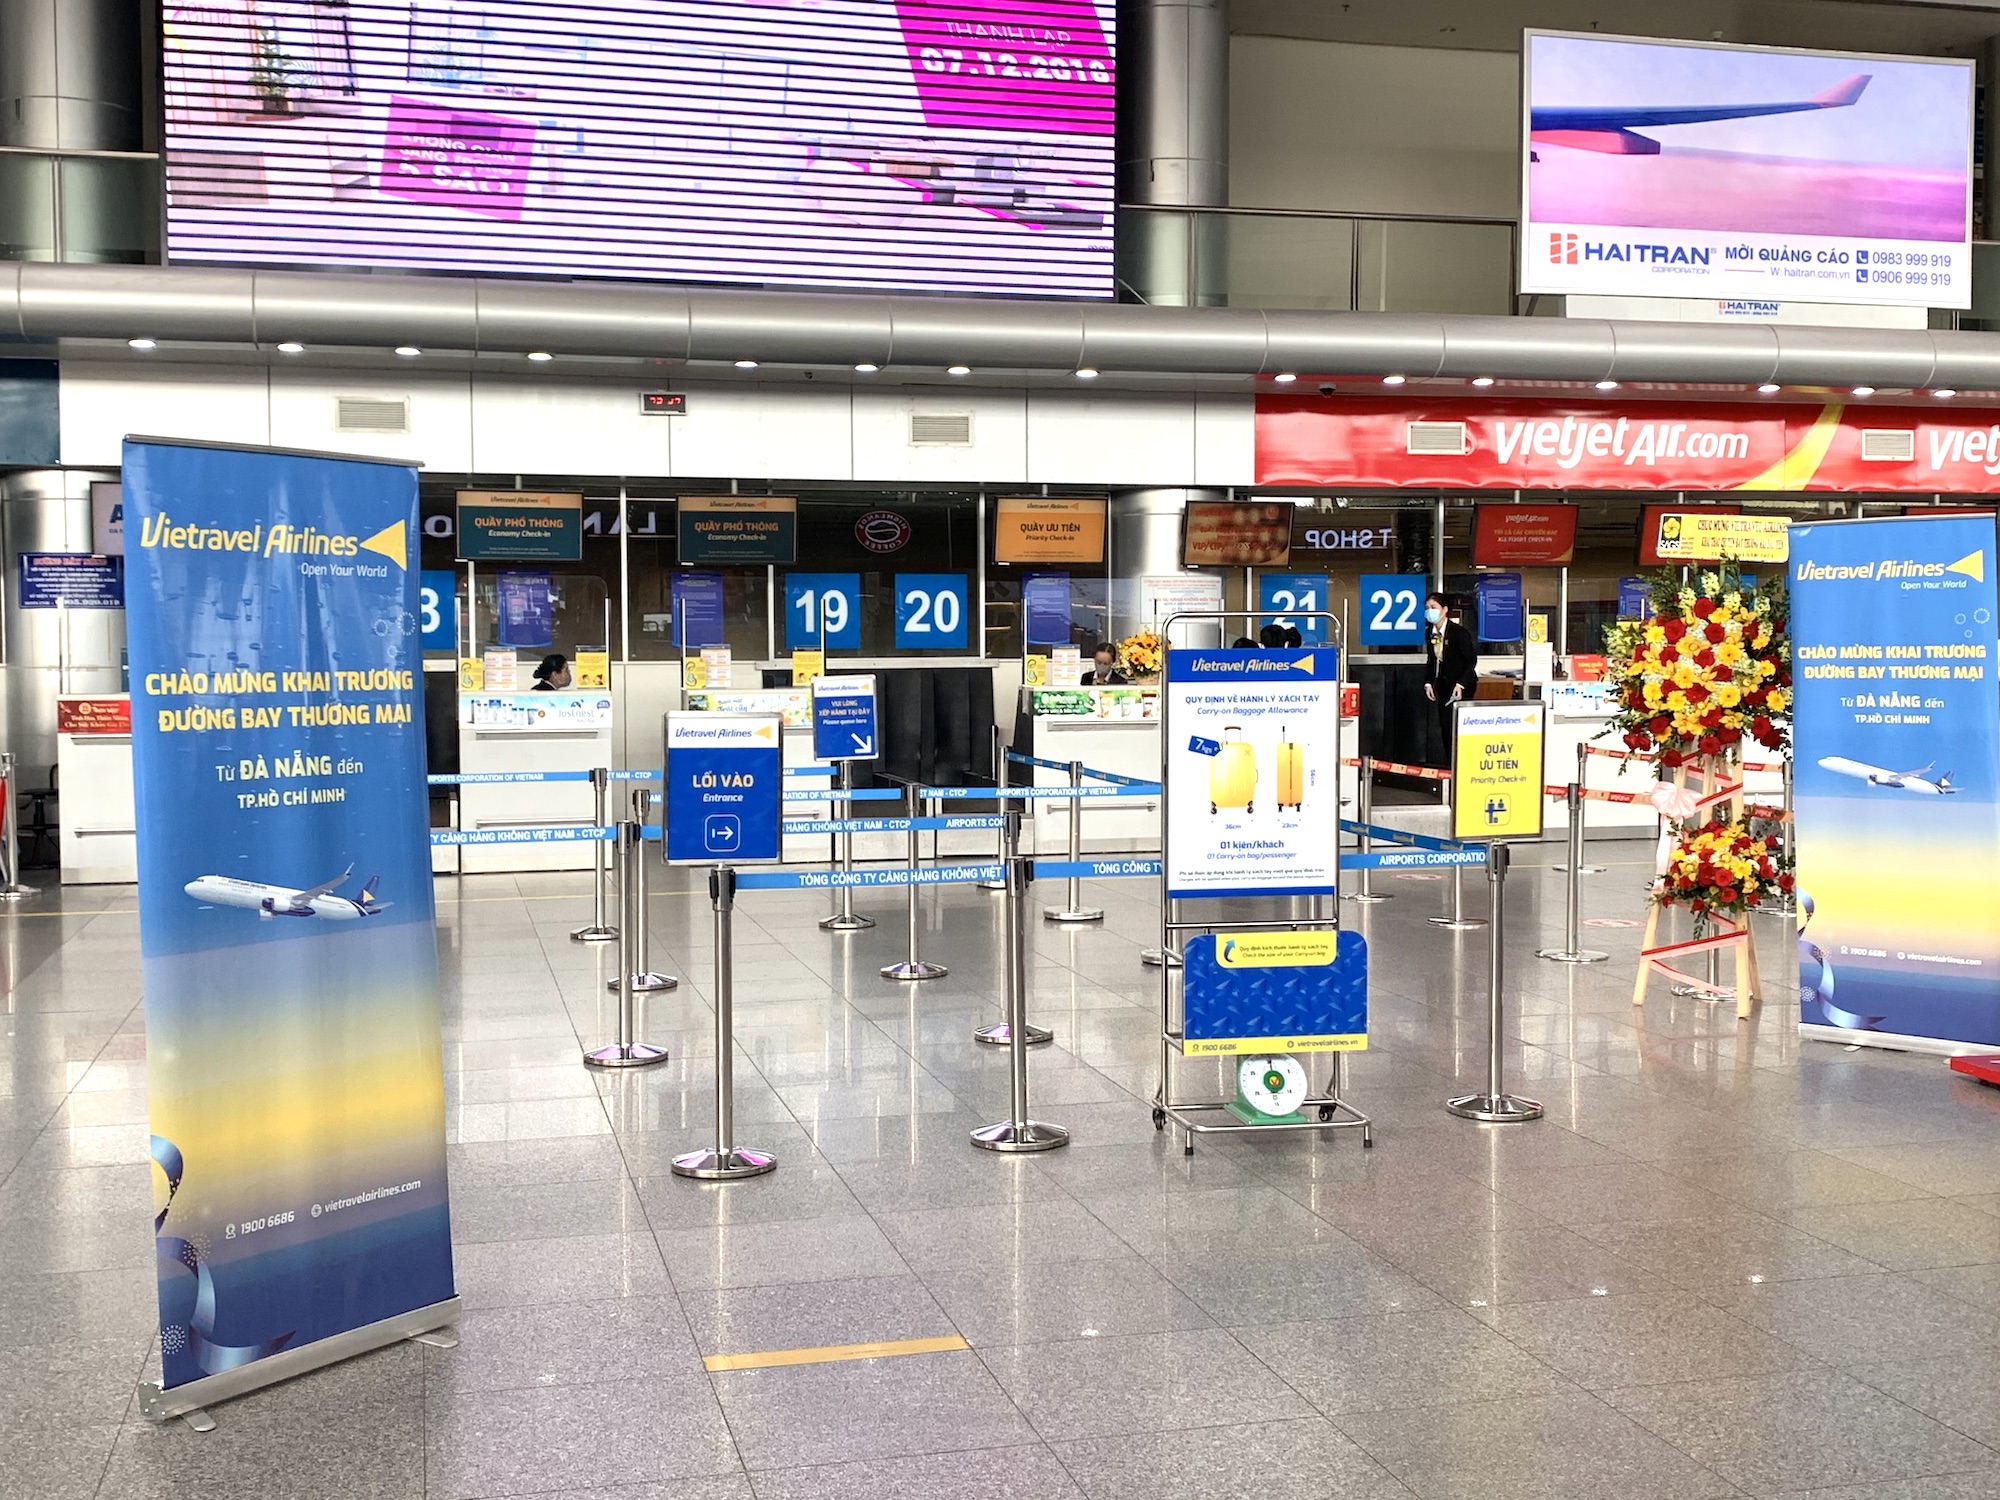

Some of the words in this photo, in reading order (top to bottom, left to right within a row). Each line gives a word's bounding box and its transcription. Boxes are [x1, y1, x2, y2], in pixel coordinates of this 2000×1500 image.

[919, 48, 1110, 83] 07.12.2018
[1725, 244, 1754, 260] MỜI
[1758, 245, 1812, 263] QUẢNG
[1817, 248, 1850, 264] CÁO
[1872, 252, 1902, 265] 0983
[1905, 253, 1928, 266] 999
[1931, 255, 1951, 267] 919
[1651, 266, 1710, 275] CORPORATION
[1784, 268, 1850, 279] haitran.com.vn
[1872, 270, 1902, 284] 0906
[1905, 272, 1928, 285] 999
[1931, 273, 1951, 286] 919
[528, 516, 564, 528] THÔNG
[745, 521, 779, 531] THÔNG
[1020, 520, 1045, 533] QUẦY
[1046, 522, 1059, 532] ƯU
[1061, 522, 1081, 532] TIÊN
[140, 511, 261, 553] Vietravel
[263, 523, 358, 558] Airlines
[488, 529, 521, 538] Economy
[521, 529, 552, 538] Check-in
[707, 533, 738, 542] Economy
[739, 533, 767, 541] Check-in
[1025, 534, 1048, 542] Priority
[300, 562, 327, 577] Open
[330, 563, 353, 577] Your
[356, 564, 388, 578] World
[1797, 560, 1875, 581] Vietravel
[1875, 560, 1945, 581] Airlines
[1901, 581, 1921, 590] Open
[1923, 581, 1940, 589] Your
[1942, 580, 1967, 588] World
[795, 589, 848, 633] 19
[904, 589, 960, 633] 20
[1271, 589, 1316, 631] 21
[1369, 589, 1418, 631] 22
[1797, 644, 1837, 659] CHÀO
[1840, 643, 1883, 659] MỪNG
[1885, 645, 1922, 659] KHAI
[1924, 643, 1986, 659] TRƯƠNG
[1191, 657, 1245, 672] Vietravel
[1245, 658, 1290, 673] Airlines
[1804, 663, 1855, 679] ĐƯỜNG
[1858, 665, 1886, 679] BAY
[1889, 664, 1950, 679] THƯƠNG
[1953, 665, 1984, 682] MẠI
[145, 668, 208, 696] CHÀO
[214, 667, 277, 694] MỪNG
[282, 671, 331, 693] KHAI
[334, 668, 414, 691] TRƯƠNG
[1185, 696, 1203, 705] QUY
[1205, 696, 1225, 706] ĐỊNH
[1227, 693, 1239, 703] VỀ
[1240, 693, 1263, 703] HÀNH
[1278, 693, 1301, 703] XÁCH
[1303, 694, 1320, 703] TAY
[1840, 696, 1855, 708] Từ
[1856, 692, 1876, 708] ĐÀ
[1879, 690, 1921, 708] NẴNG
[1924, 697, 1945, 708] đến
[158, 704, 236, 732] ĐƯỜNG
[241, 706, 282, 728] BAY
[287, 704, 370, 728] THƯƠNG
[375, 703, 412, 729] MẠI
[1197, 707, 1232, 716] Carry-on
[1232, 706, 1266, 716] Baggage
[1267, 706, 1309, 714] Allowance
[1854, 711, 1882, 724] TP.HỒ
[1884, 712, 1902, 724] CHÍ
[1903, 714, 1930, 724] MINH
[1462, 716, 1495, 725] Vietravel
[1495, 716, 1522, 726] Airlines
[675, 727, 716, 739] Vietravel
[717, 728, 753, 740] Airlines
[216, 764, 235, 782] Từ
[239, 754, 269, 780] ĐÀ
[275, 749, 332, 778] NẴNG
[337, 756, 364, 776] đến
[1479, 759, 1494, 771] ƯU
[1496, 757, 1519, 770] TIÊN
[456, 774, 504, 782] CORPORATION
[504, 773, 513, 781] OF
[615, 771, 631, 779] NAM
[635, 771, 652, 779] CTCP
[692, 770, 717, 788] LỐI
[720, 771, 754, 788] VÀO
[1470, 776, 1496, 785] Priority
[1498, 775, 1527, 784] Check-in
[237, 788, 279, 809] TP.HỒ
[282, 786, 308, 807] CHÍ
[311, 787, 346, 804] MINH
[702, 792, 744, 802] Entrance
[809, 791, 819, 799] OF
[820, 791, 852, 799] VIETNAM
[928, 788, 944, 797] NAM
[949, 788, 967, 797] CTCP
[995, 787, 1030, 796] AIRPORTS
[1030, 786, 1078, 796] CORPORATION
[1078, 786, 1088, 795] OF
[1089, 786, 1118, 795] VIETNAM
[785, 821, 809, 833] HÀNG
[811, 820, 842, 832] KHÔNG
[843, 820, 863, 832] VIỆT
[864, 821, 883, 830] NAM
[889, 820, 911, 829] CTCP
[946, 818, 987, 828] AIRPORTS
[440, 831, 467, 844] CẢNG
[469, 830, 496, 842] HÀNG
[498, 829, 531, 841] KHÔNG
[532, 829, 554, 842] VIỆT
[554, 830, 575, 840] NAM
[582, 828, 606, 839] CTCP
[1220, 841, 1231, 849] 01
[1216, 853, 1246, 861] Carry-on
[1247, 852, 1297, 860] bag/passenger
[1379, 854, 1426, 866] AIRPORTS
[1426, 852, 1486, 864] CORPORATIO
[1093, 862, 1121, 875] TỔNG
[1122, 860, 1151, 873] CÔNG
[799, 873, 829, 887] TỔNG
[830, 870, 862, 885] CÔNG
[863, 872, 877, 883] TY
[878, 868, 909, 882] CẢNG
[910, 868, 941, 882] HÀNG
[941, 866, 978, 881] KHÔNG
[978, 865, 1002, 881] VIỆT
[1850, 947, 1867, 956] 1900
[1868, 949, 1887, 958] 6686
[1907, 952, 1983, 966] vietravelairlines.com
[1219, 1043, 1237, 1051] 6686
[240, 1217, 266, 1235] 1900
[267, 1210, 295, 1228] 6686
[324, 1179, 422, 1213] vietravelairlines.com
